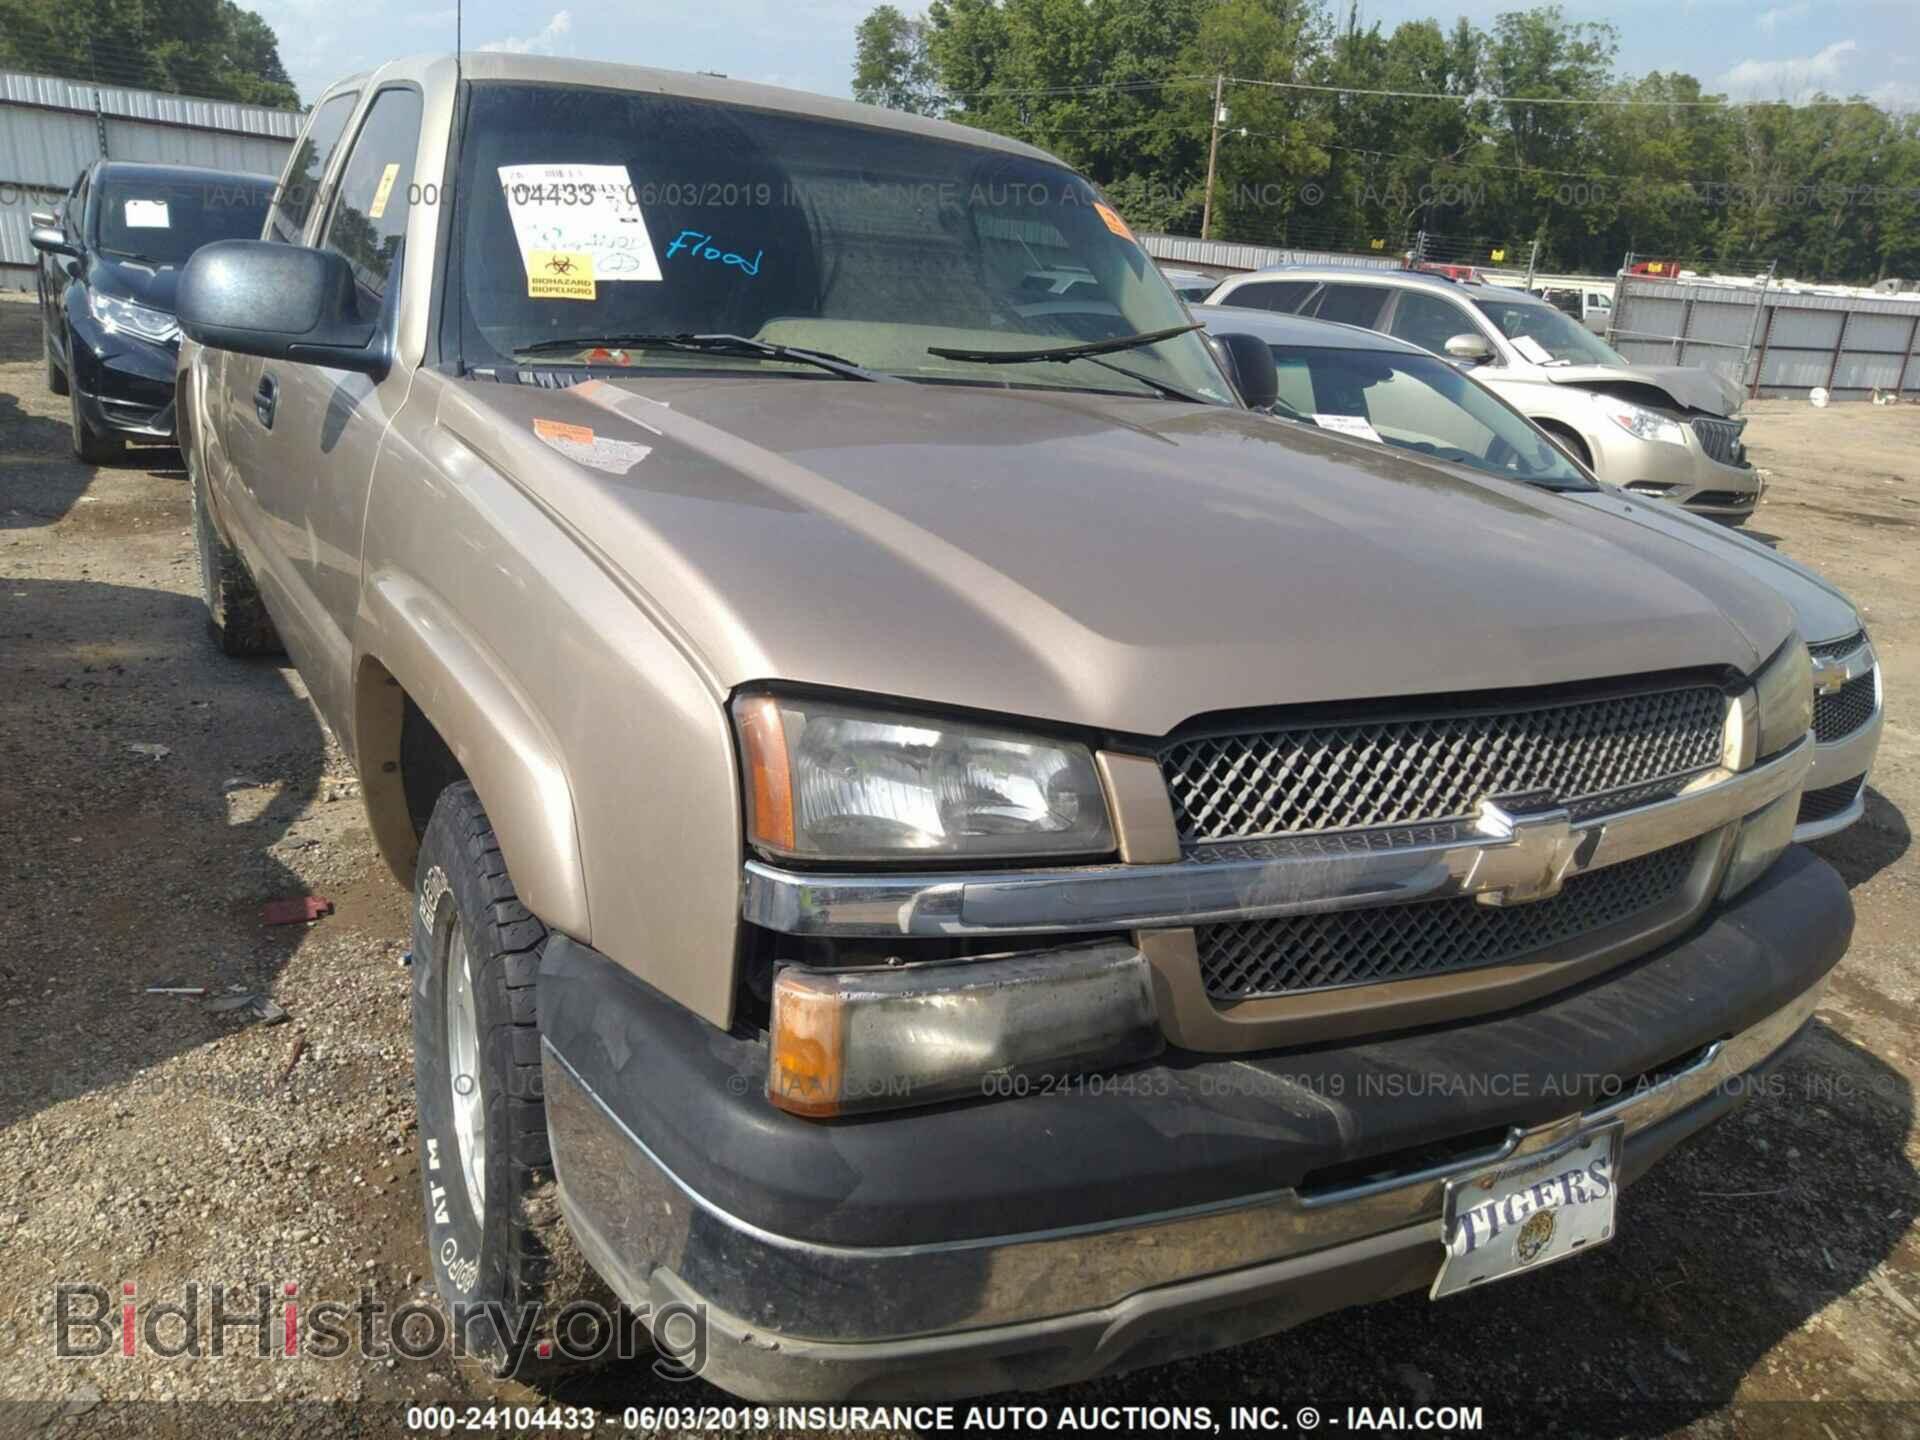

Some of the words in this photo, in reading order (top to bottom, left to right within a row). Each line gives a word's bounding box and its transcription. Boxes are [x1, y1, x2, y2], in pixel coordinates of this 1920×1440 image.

[667, 231, 763, 276] Flood
[532, 278, 592, 287] BIOHAZARD
[532, 286, 592, 296] BIOPELIGRO
[1456, 1157, 1611, 1254] TIGERS
